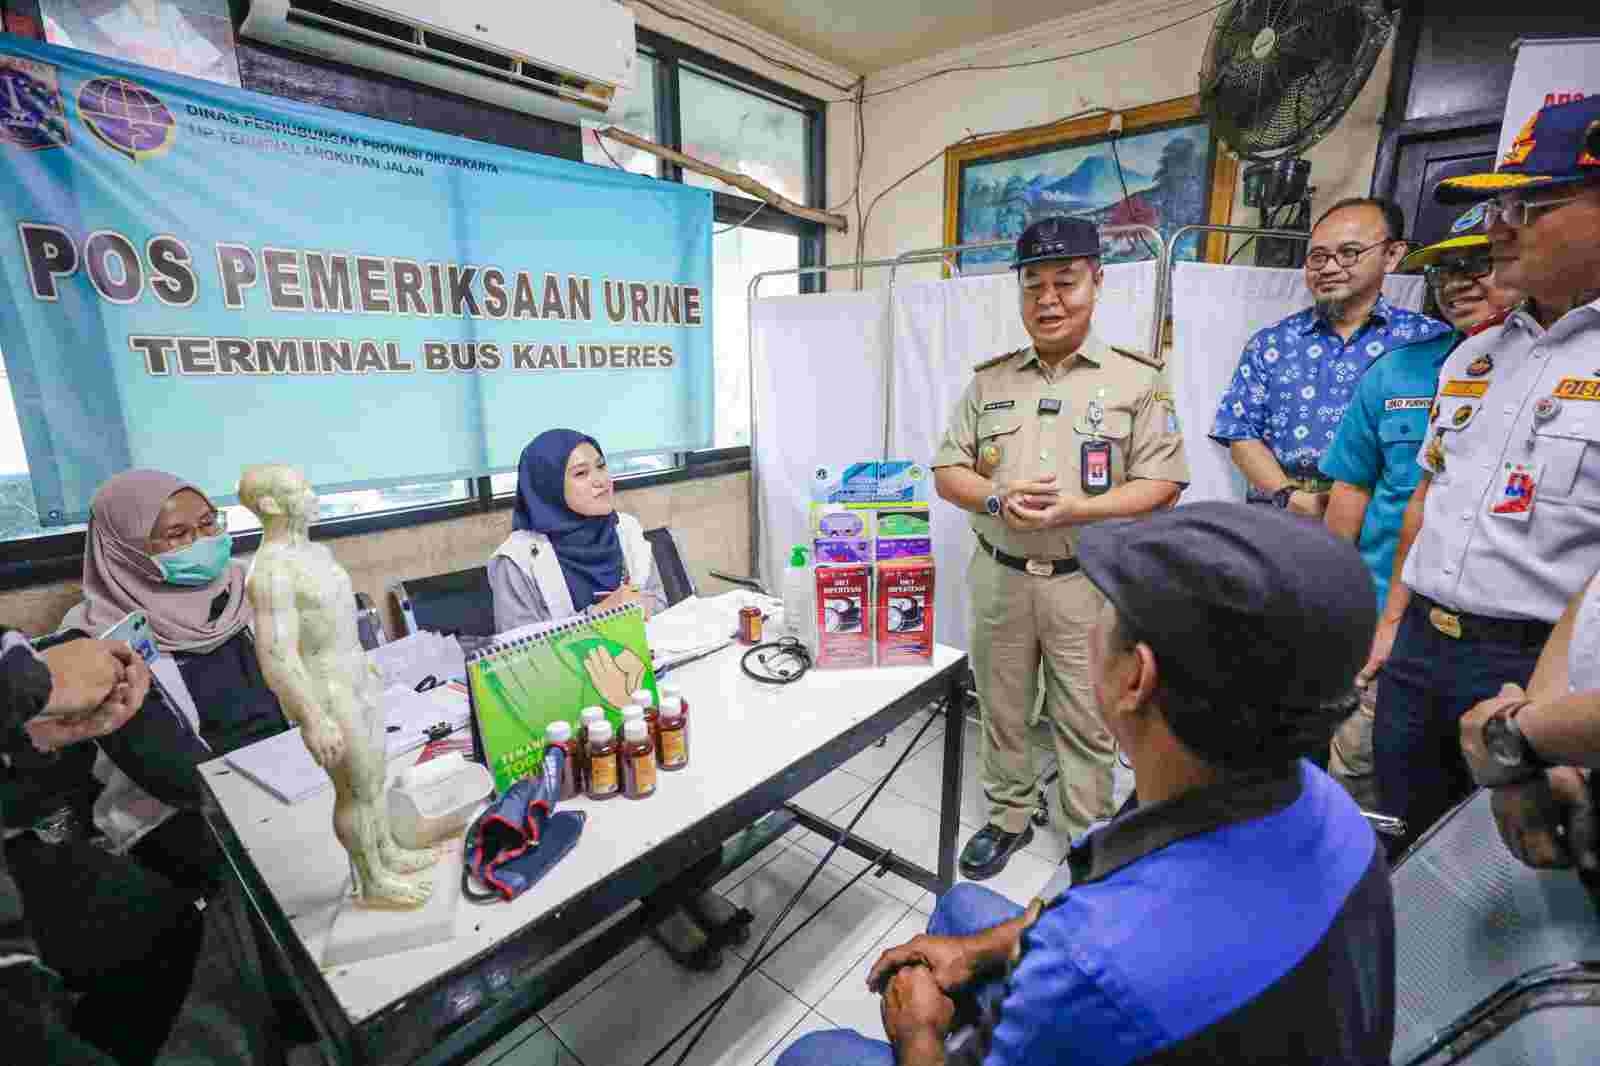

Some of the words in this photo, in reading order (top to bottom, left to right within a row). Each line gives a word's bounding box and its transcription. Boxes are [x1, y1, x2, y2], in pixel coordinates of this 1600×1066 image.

[184, 103, 240, 126] DINAS
[362, 138, 423, 161] PROVINSI
[382, 159, 425, 177] JALAN
[18, 220, 198, 307] POS
[216, 240, 594, 321] PEMERIKSAAN
[602, 279, 703, 328] URINE
[129, 334, 416, 376] TERMINAL
[423, 340, 501, 374] BUS
[512, 342, 675, 372] KALIDERES
